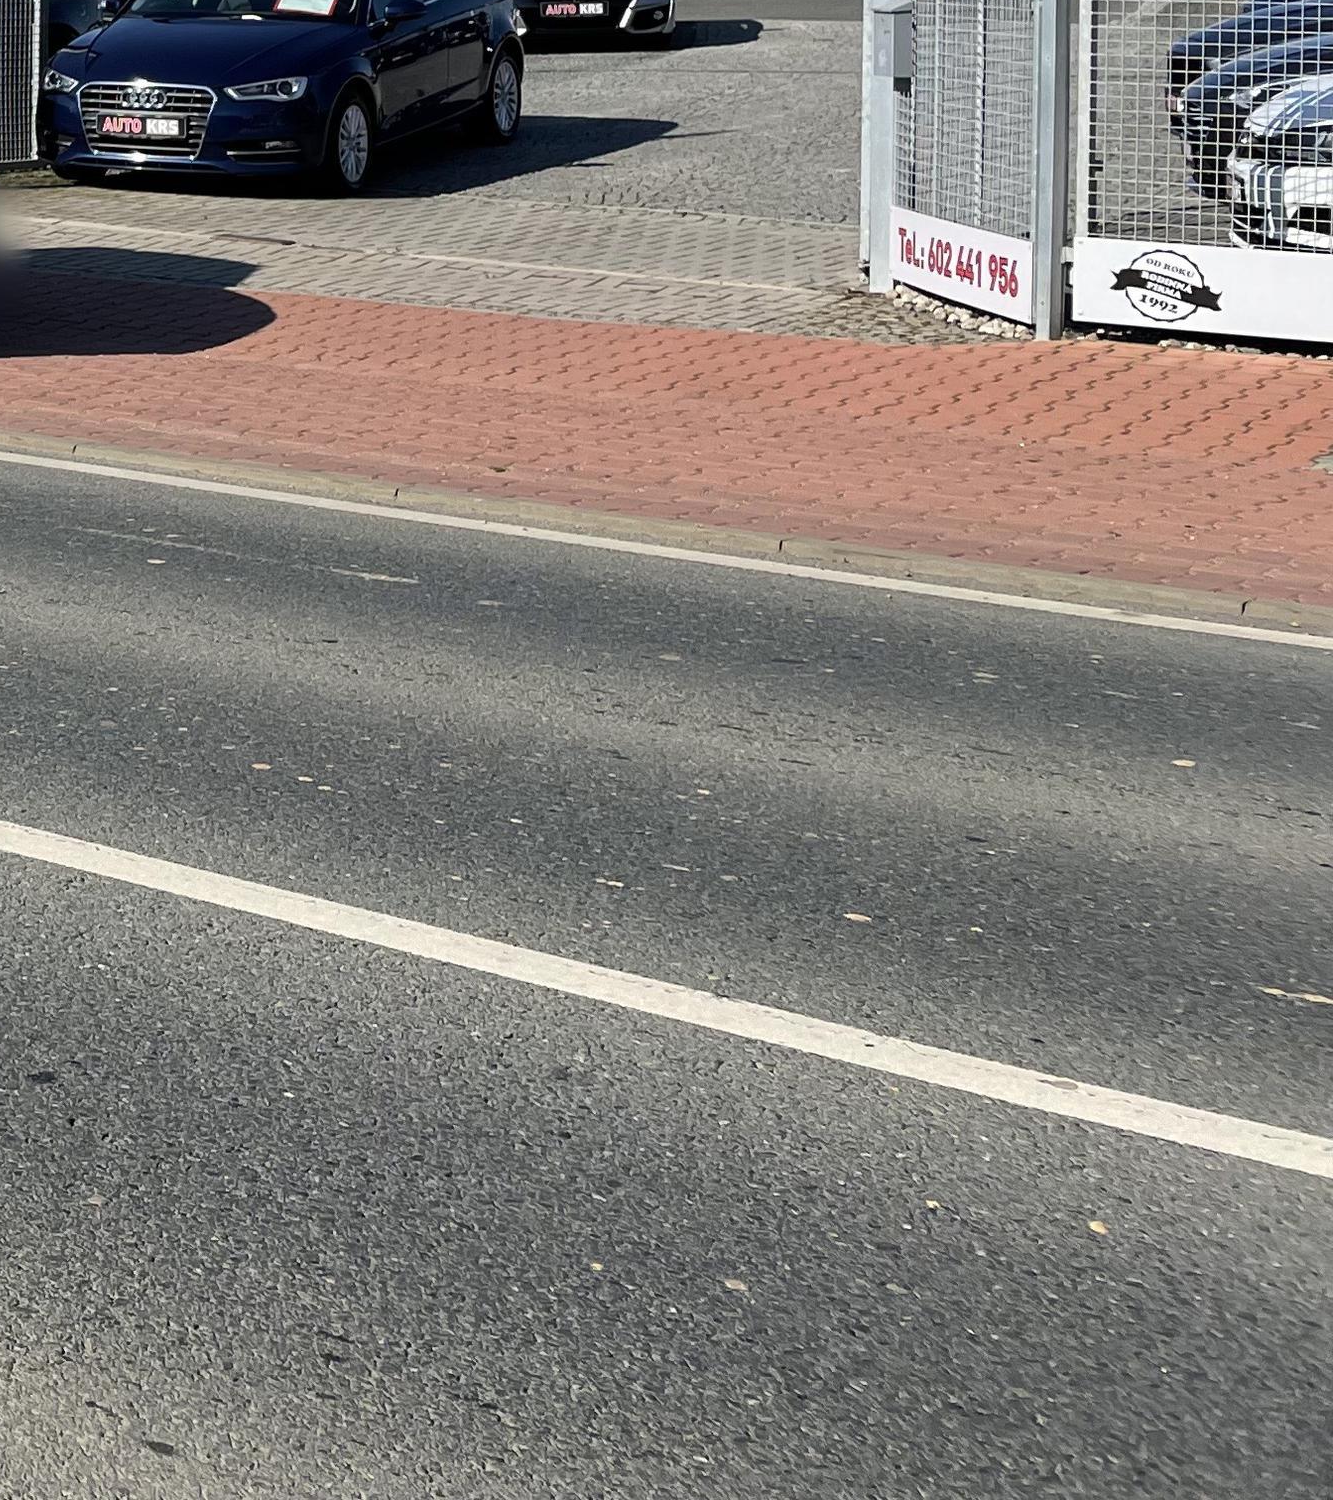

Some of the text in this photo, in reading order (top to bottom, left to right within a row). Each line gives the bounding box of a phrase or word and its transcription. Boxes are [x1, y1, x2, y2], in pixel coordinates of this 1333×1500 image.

[546, 2, 603, 15] AUTO KRS
[102, 116, 179, 135] AUTO KRS
[928, 237, 952, 278] 602
[956, 246, 982, 288] 441
[988, 254, 1019, 298] 956
[1163, 263, 1195, 278] ROKU
[1140, 294, 1178, 314] 1992
